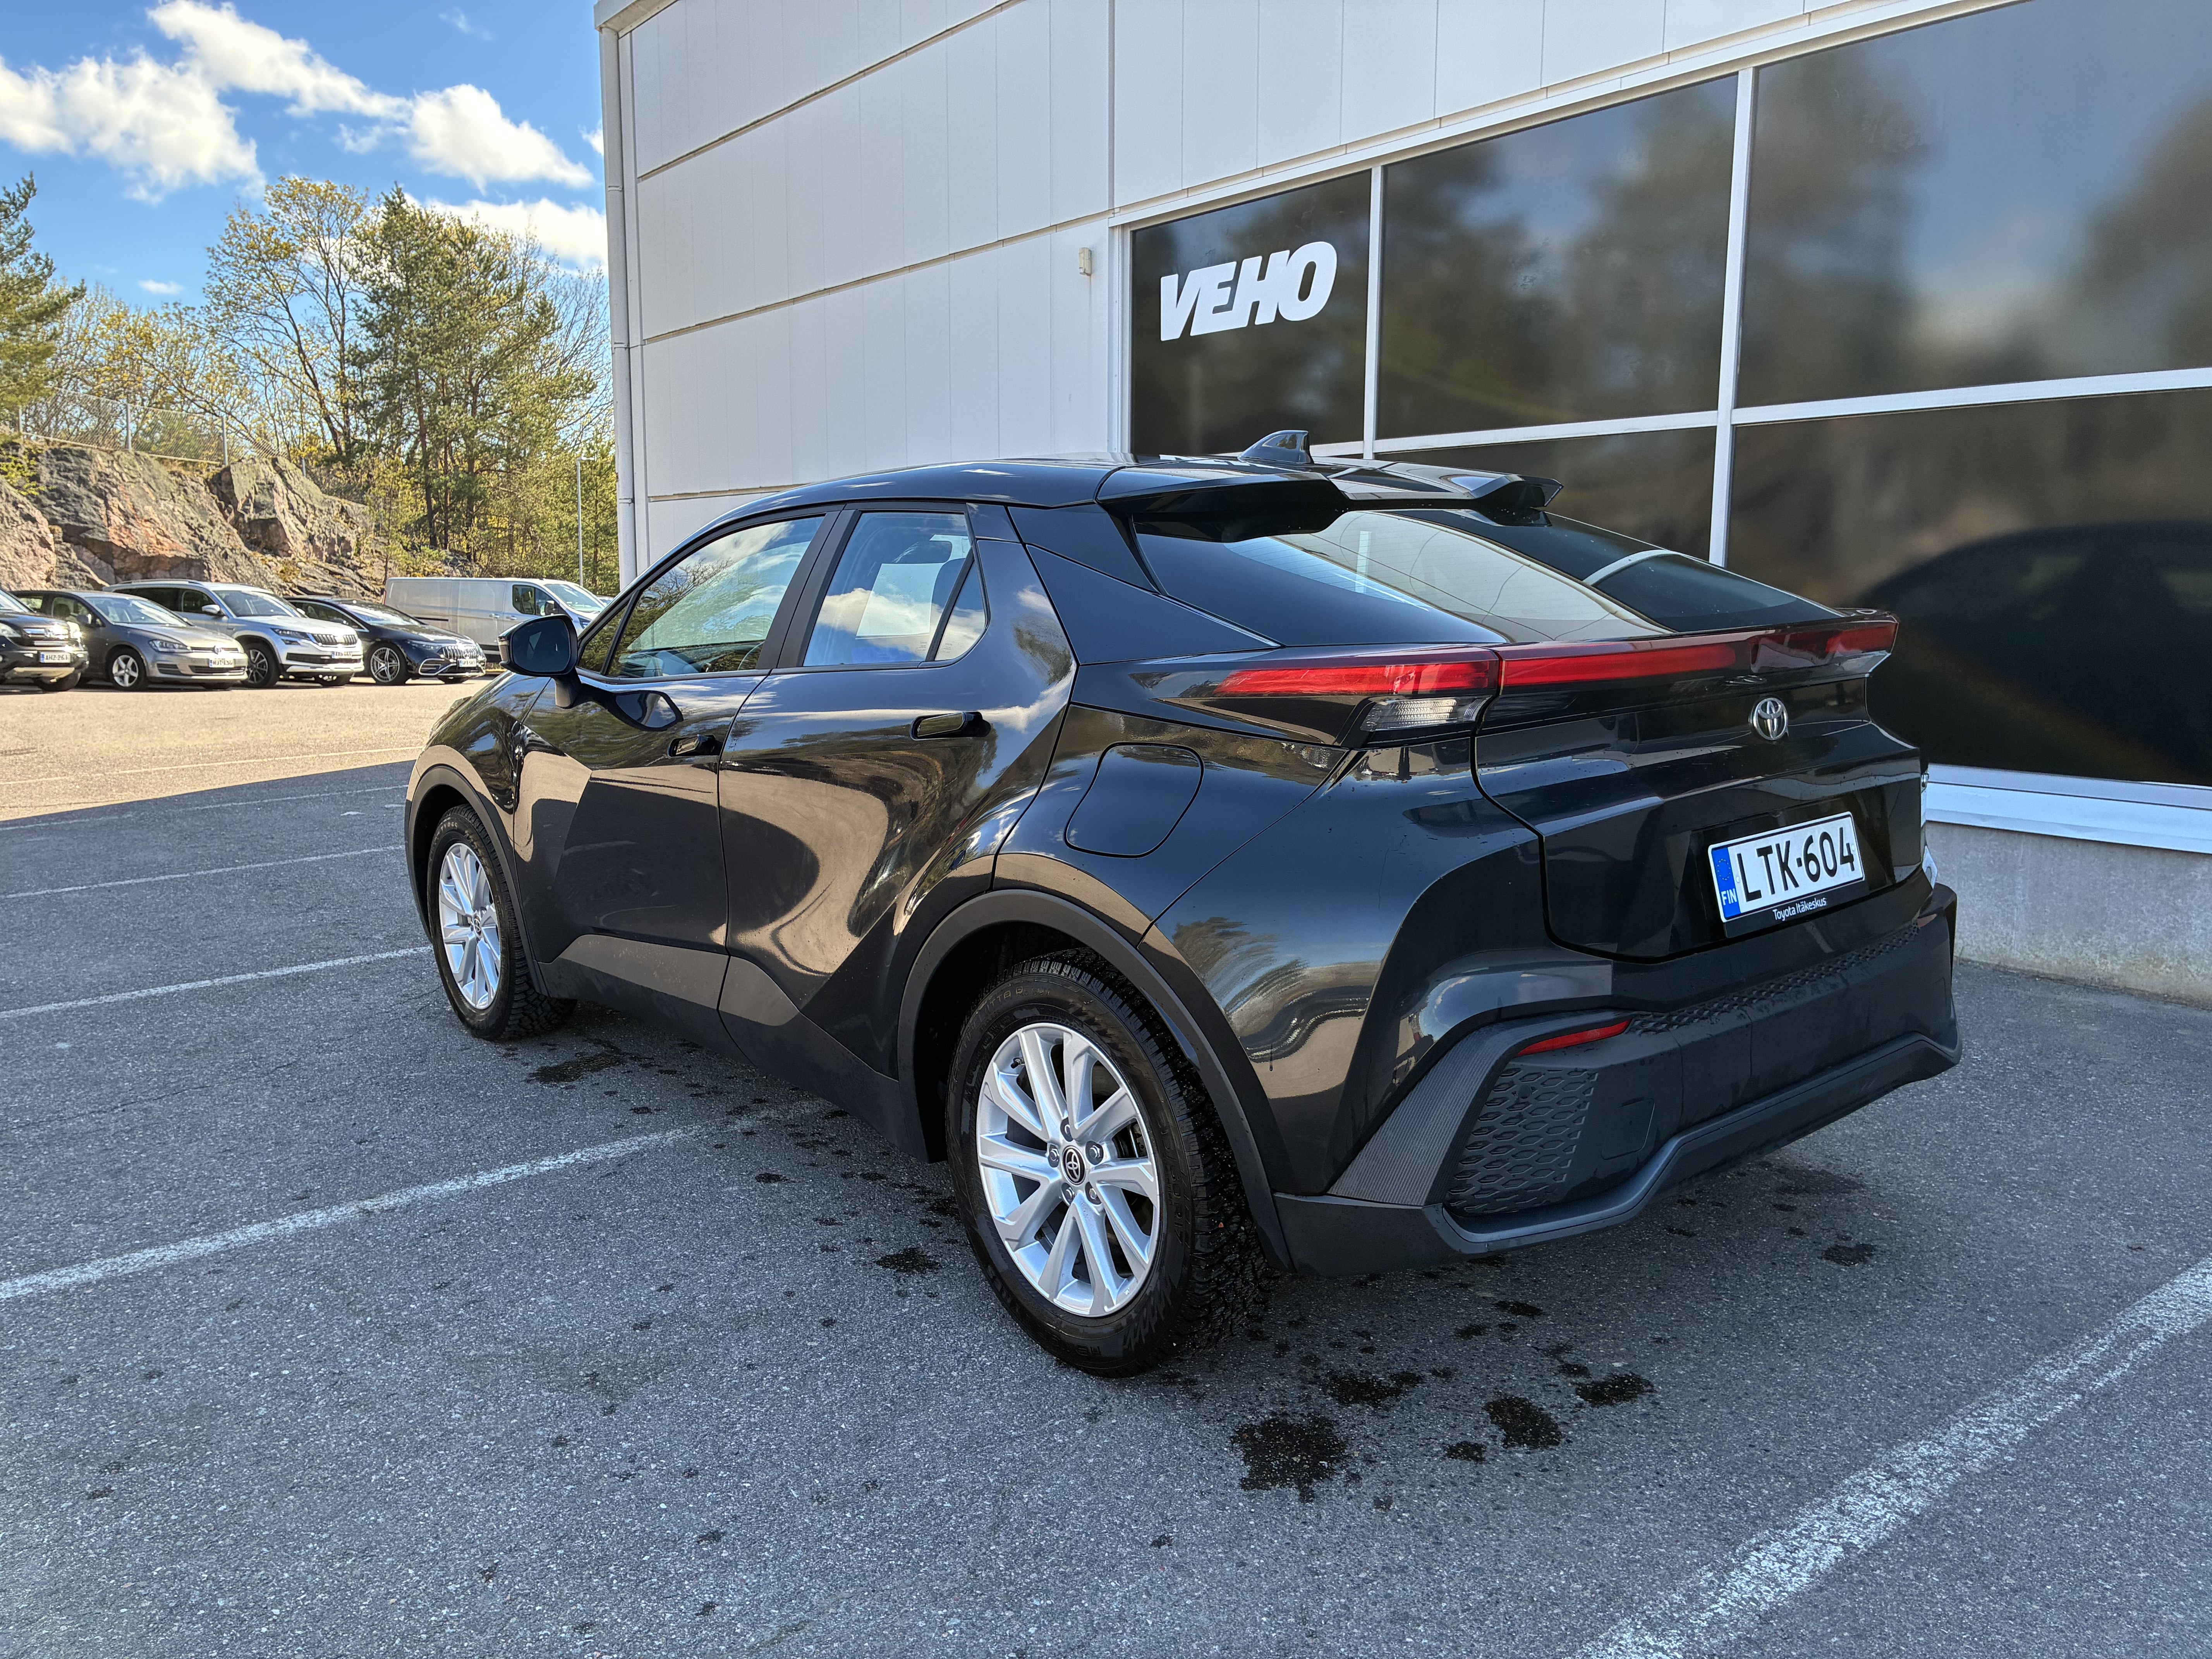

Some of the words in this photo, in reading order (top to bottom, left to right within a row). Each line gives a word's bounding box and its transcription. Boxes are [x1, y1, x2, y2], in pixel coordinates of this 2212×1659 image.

[1161, 241, 1337, 341] VEHO
[1736, 827, 1855, 902] LTK-604
[1721, 888, 1738, 906] FIN
[1773, 905, 1796, 921] Toyota
[1796, 896, 1827, 915] Itäkeskus
